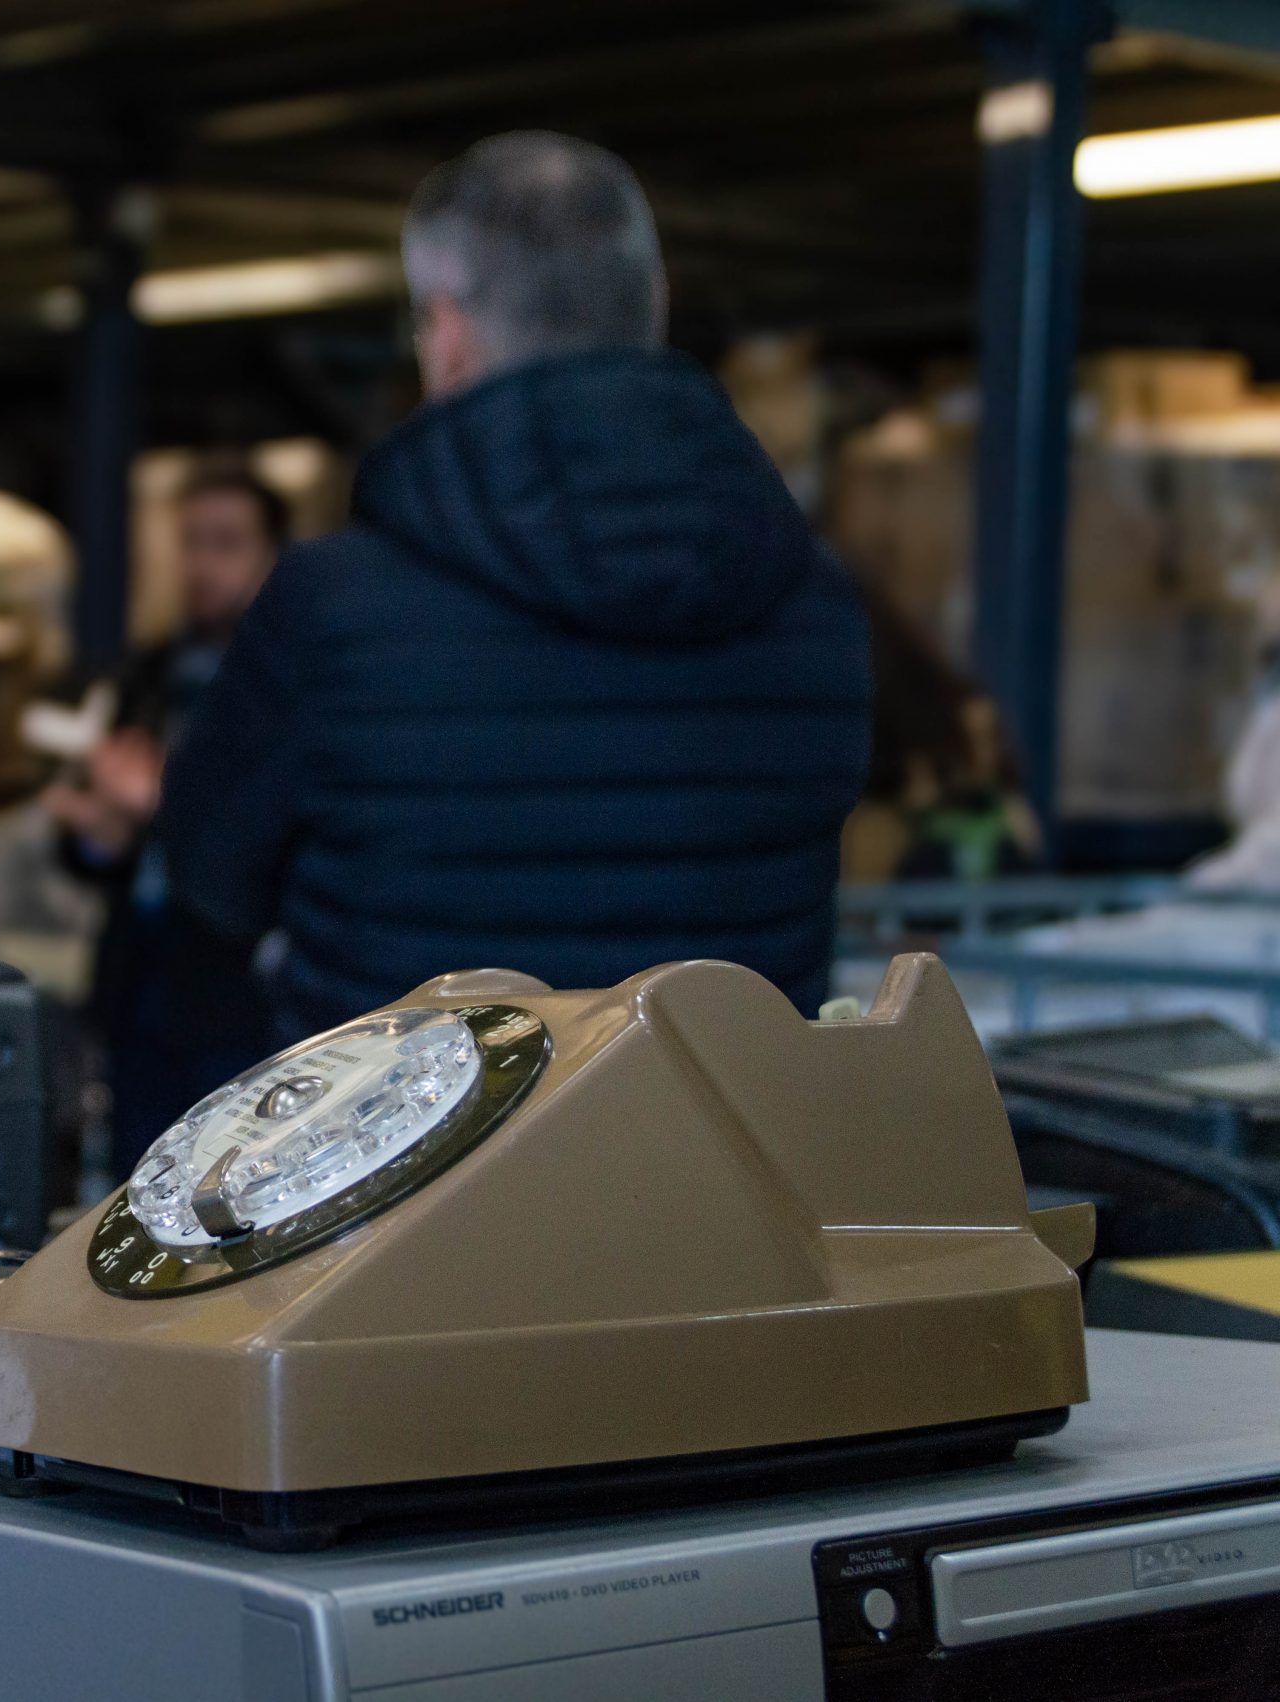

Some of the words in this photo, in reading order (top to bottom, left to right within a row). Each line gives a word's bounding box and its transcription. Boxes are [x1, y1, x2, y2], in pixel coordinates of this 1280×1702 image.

[485, 1024, 511, 1037] 2
[499, 1054, 519, 1068] 1
[113, 1236, 135, 1253] 9
[848, 1547, 894, 1562] PICTURE
[1197, 1549, 1244, 1564] VIDEO
[840, 1557, 907, 1576] ADJUSTMENT
[372, 1591, 505, 1627] SCHNEIDER
[580, 1582, 608, 1598] DVD
[609, 1576, 649, 1593] VIDEO
[652, 1568, 701, 1586] PLAYER
